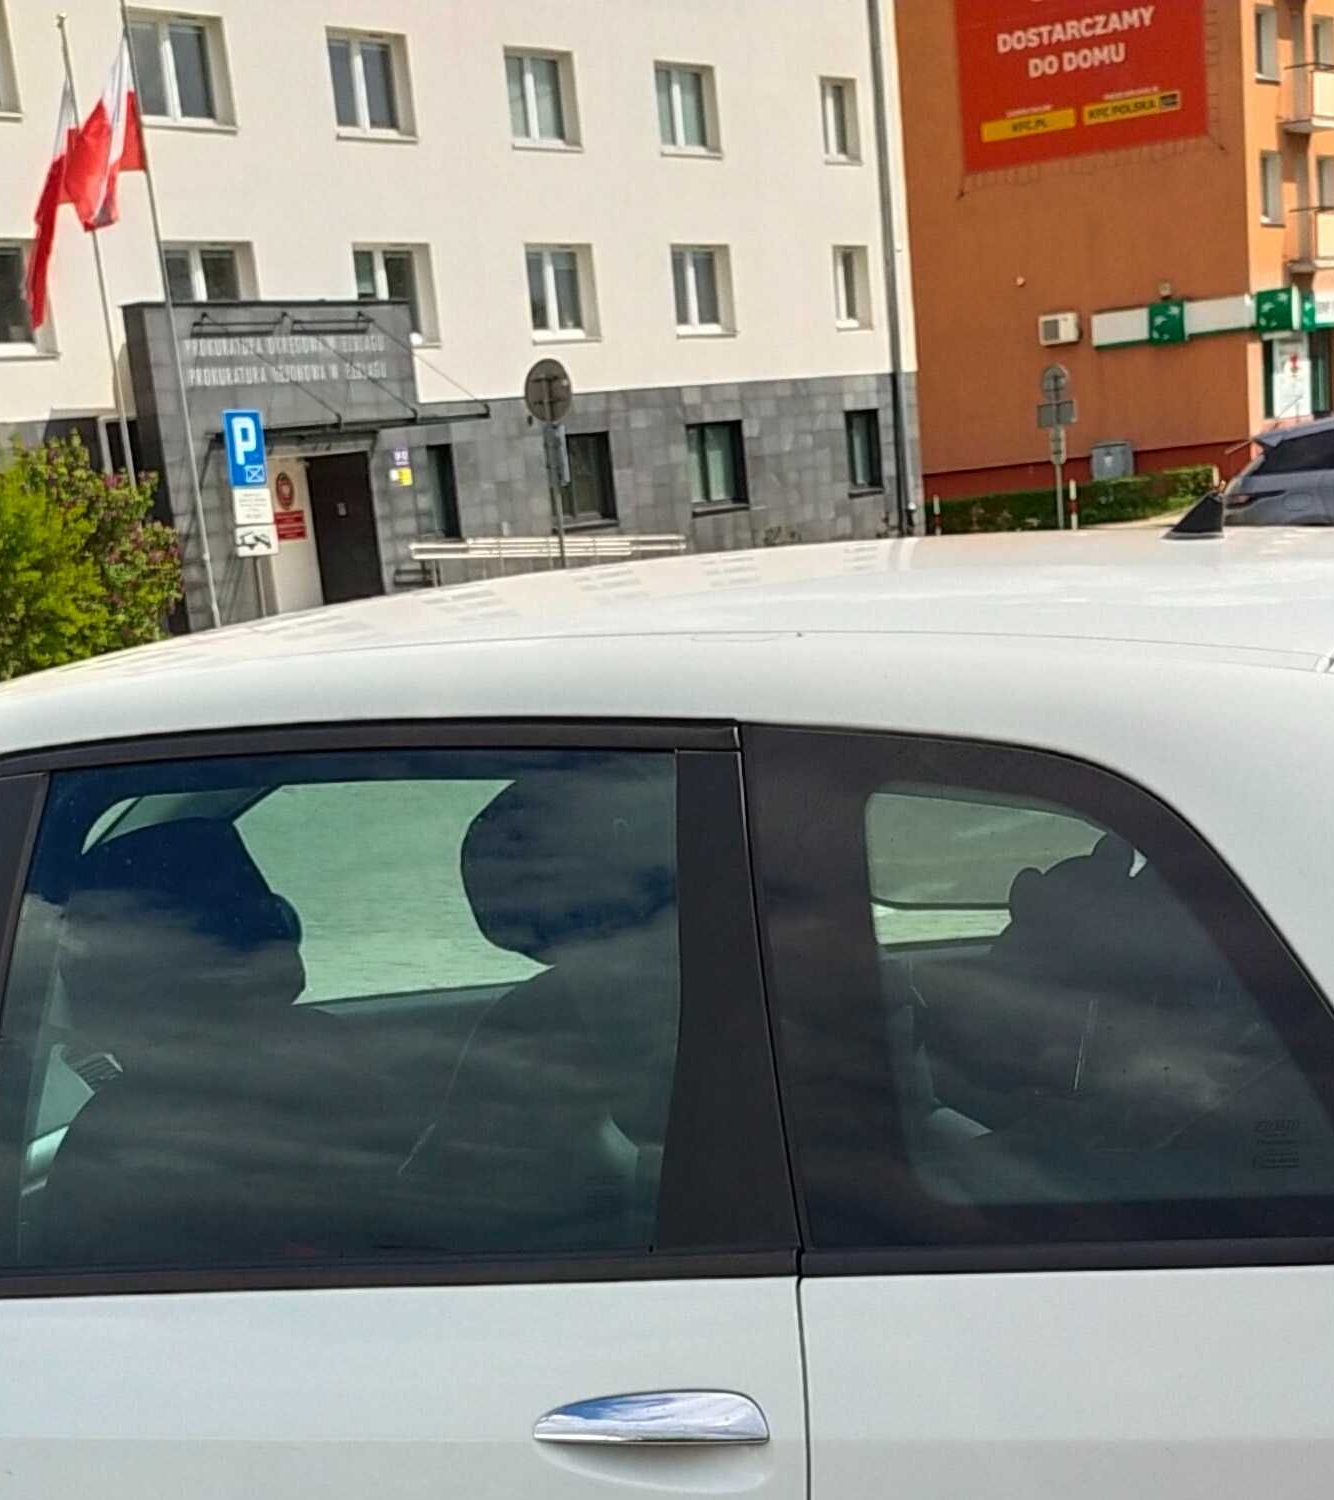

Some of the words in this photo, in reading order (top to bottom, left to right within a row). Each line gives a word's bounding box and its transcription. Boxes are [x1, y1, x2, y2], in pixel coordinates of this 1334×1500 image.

[996, 6, 1155, 53] DOSTARCZAMY
[1028, 56, 1059, 78] DO
[1062, 42, 1126, 72] DOMU
[184, 337, 264, 356] PROKURATURA
[189, 366, 267, 386] PROKURATURA
[231, 416, 257, 466] P
